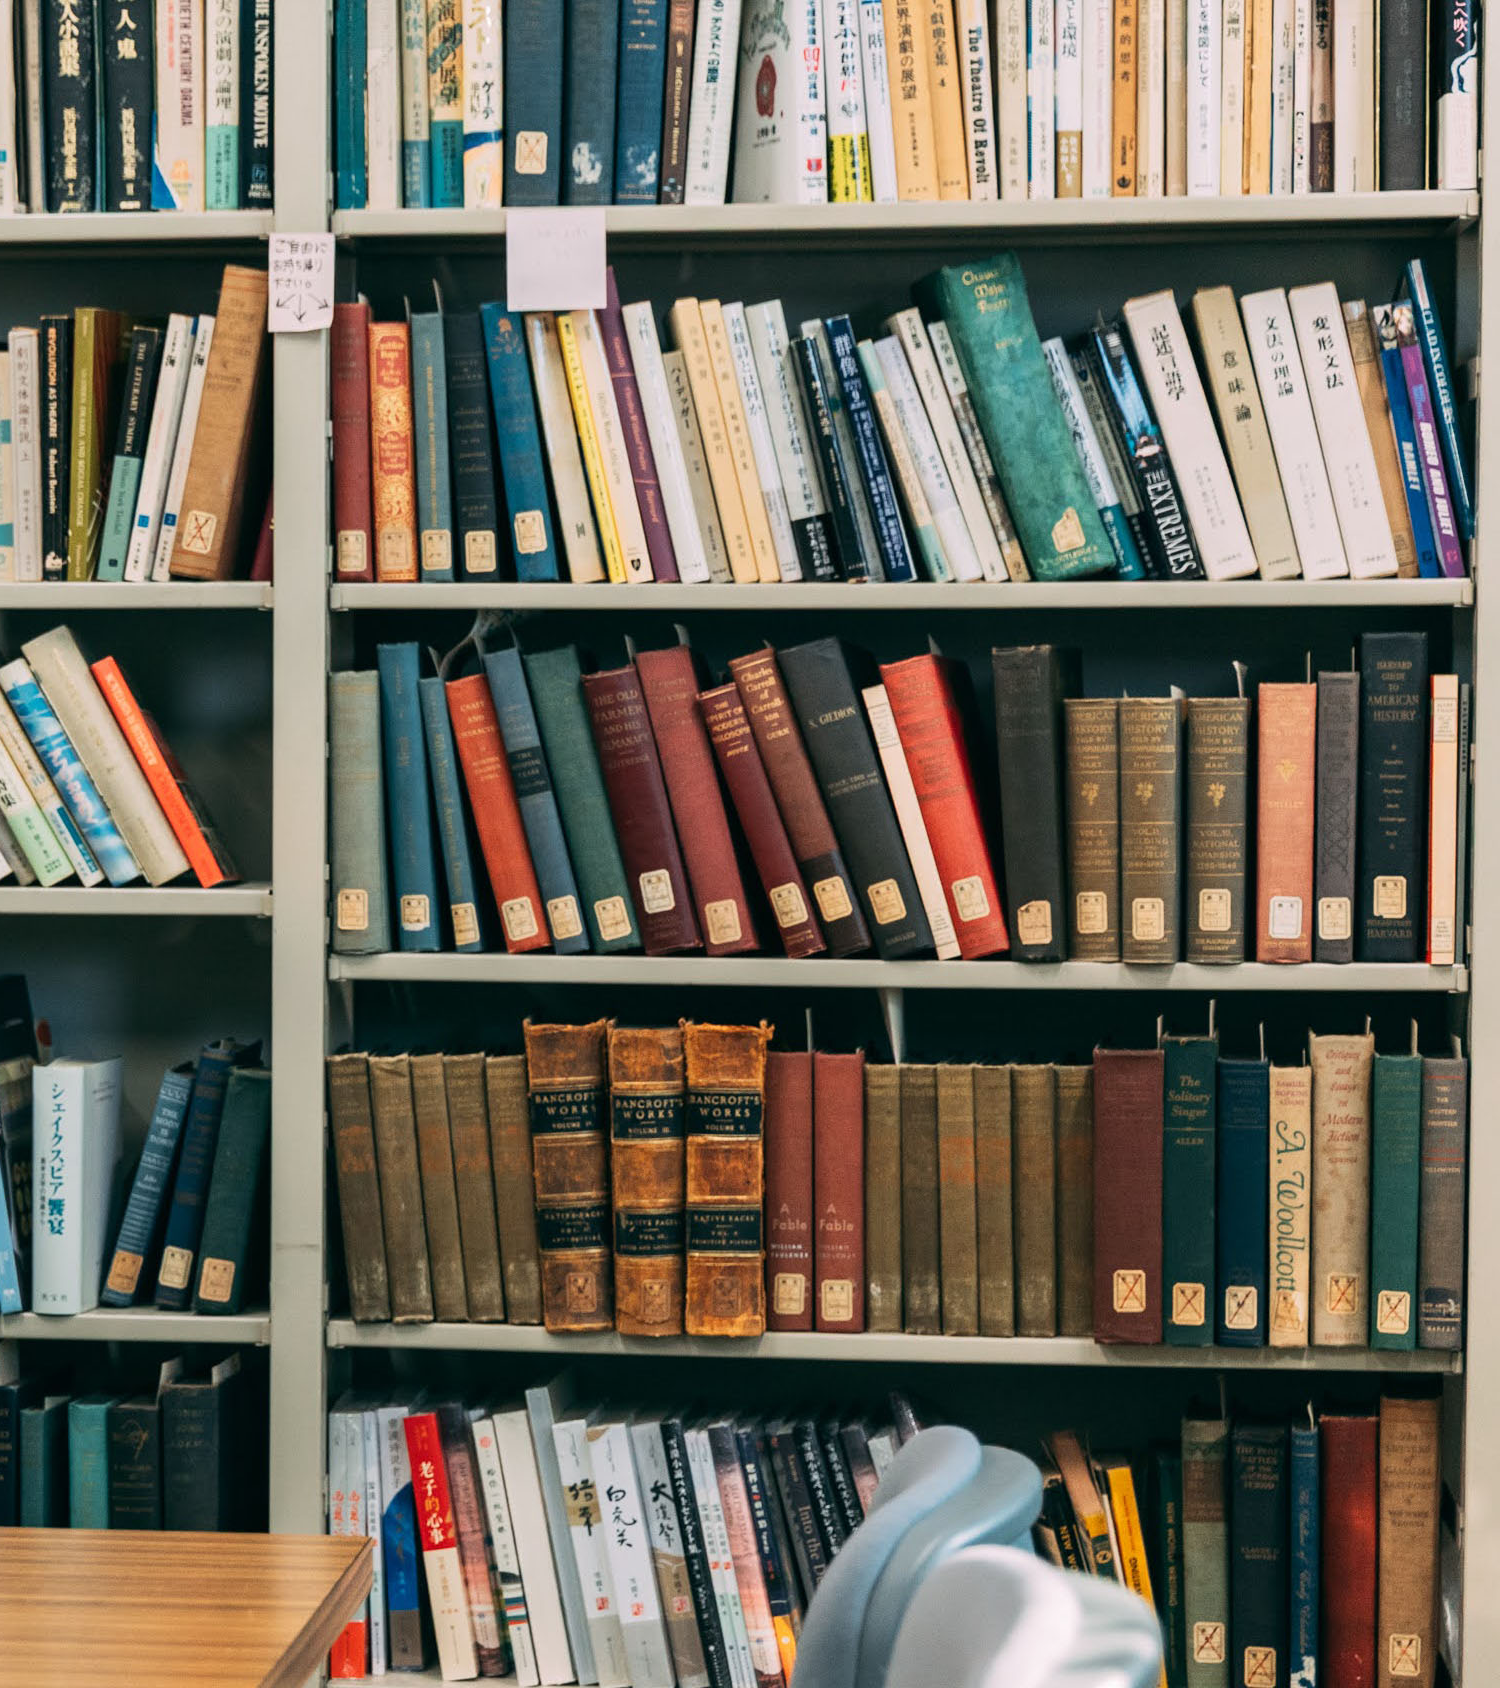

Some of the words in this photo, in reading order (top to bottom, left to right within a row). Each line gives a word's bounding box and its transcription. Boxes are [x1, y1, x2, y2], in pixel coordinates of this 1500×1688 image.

[968, 26, 982, 51] The
[254, 20, 268, 92] UNSPOKEN
[969, 57, 986, 114] Theatre
[179, 88, 192, 127] DRAMA
[254, 94, 268, 147] MOTIVE
[974, 139, 989, 182] Revolt
[46, 327, 57, 385] REVOLUTION
[1265, 314, 1296, 399] 文法の理論
[1311, 313, 1345, 391] 変形文法
[47, 387, 56, 399] AS
[125, 365, 145, 412] LITERARY
[1220, 349, 1253, 422] 意味論
[47, 401, 56, 438] THEATRE
[1415, 419, 1441, 467] ROMEO
[1401, 441, 1421, 492] HAMLET
[1145, 471, 1166, 483] THE
[1426, 466, 1448, 496] AND
[1432, 495, 1456, 538] JULIET
[1147, 480, 1198, 576] EXTREMES
[1376, 660, 1413, 670] HARVARD
[740, 666, 774, 682] Charles
[745, 676, 776, 692] Carroll
[1388, 684, 1400, 692] TO
[616, 689, 637, 701] OLD
[1366, 694, 1420, 706] AMERICAN
[1372, 710, 1417, 721] HISTORY
[603, 723, 623, 735] AND
[1334, 1065, 1351, 1076] and
[1179, 1074, 1200, 1087] The
[1167, 1089, 1211, 1105] Solitary
[622, 1110, 674, 1120] WORKS
[699, 1107, 751, 1117] WORKS
[1170, 1105, 1207, 1119] Singer
[1322, 1113, 1364, 1127] Modern
[1326, 1130, 1360, 1144] Fiction
[47, 1083, 66, 1236] シェイクスピア饗宴
[780, 1203, 788, 1213] A
[826, 1203, 836, 1213] A
[772, 1218, 806, 1230] Fable
[819, 1218, 854, 1230] Fable
[798, 1504, 816, 1534] Into
[806, 1536, 822, 1560] the
